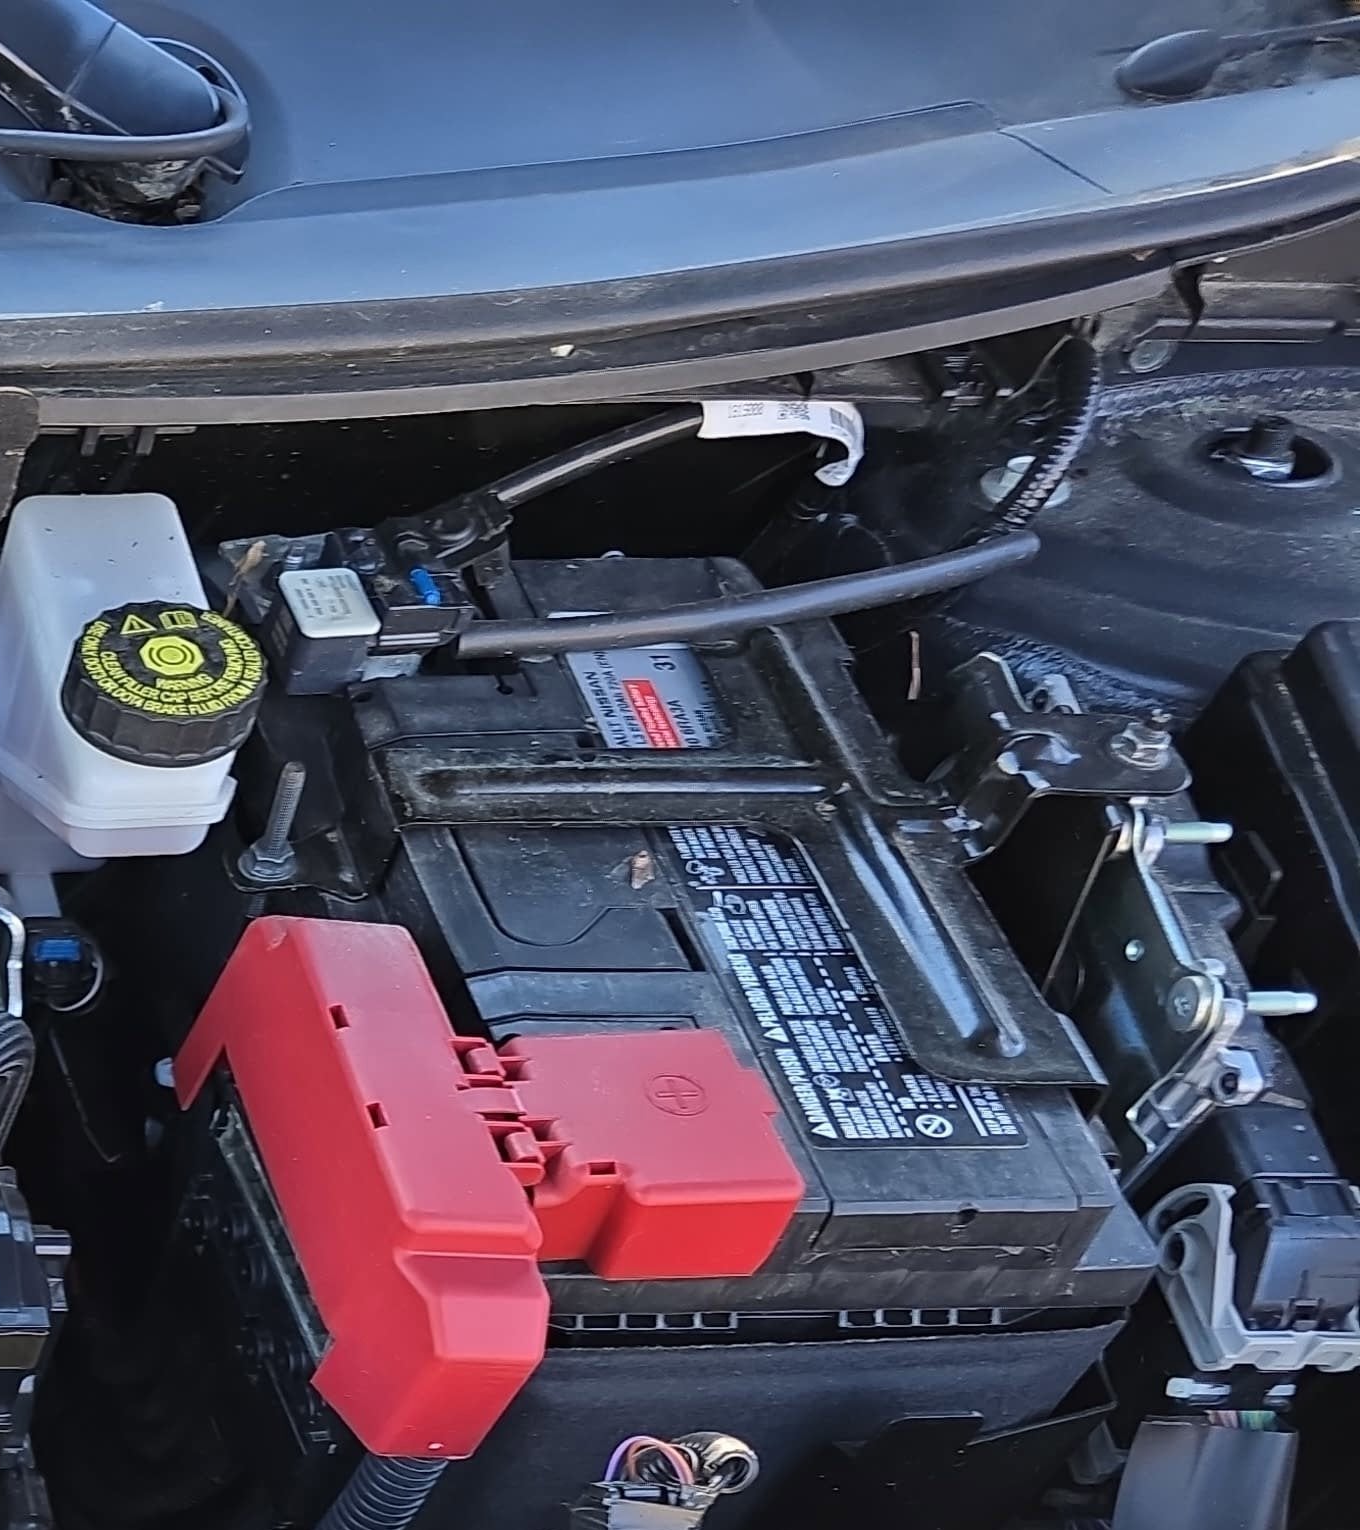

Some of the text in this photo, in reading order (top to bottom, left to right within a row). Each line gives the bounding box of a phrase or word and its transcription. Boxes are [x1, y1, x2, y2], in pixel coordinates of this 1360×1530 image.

[81, 636, 100, 657] ONLY
[83, 658, 107, 679] DOT3
[243, 650, 263, 680] SEALED
[648, 655, 677, 670] 31
[97, 678, 119, 692] OR
[101, 651, 128, 679] CLEAN
[118, 676, 160, 700] FILLER
[160, 691, 187, 703] CAP
[188, 678, 236, 700] BEFORE
[156, 673, 214, 690] WARNING
[220, 685, 253, 707] FROM
[582, 671, 616, 716] NISSAN
[142, 700, 190, 715] BRAKE
[188, 700, 226, 715] FLUID
[726, 953, 781, 1027] PELIGRO/VENENO
[838, 990, 858, 1000] NO
[773, 1048, 828, 1122] DANGER/POISON
[899, 1074, 927, 1102] SPARKS
[914, 1074, 941, 1102] FLAMES
[852, 1090, 874, 1107] CAUSE
[895, 1097, 916, 1108] NO
[861, 1108, 880, 1118] CAN
[975, 1107, 995, 1118] OUT
[992, 1112, 1013, 1124] NOT
[983, 1119, 1004, 1134] KEEP
[1000, 1125, 1019, 1133] DO
